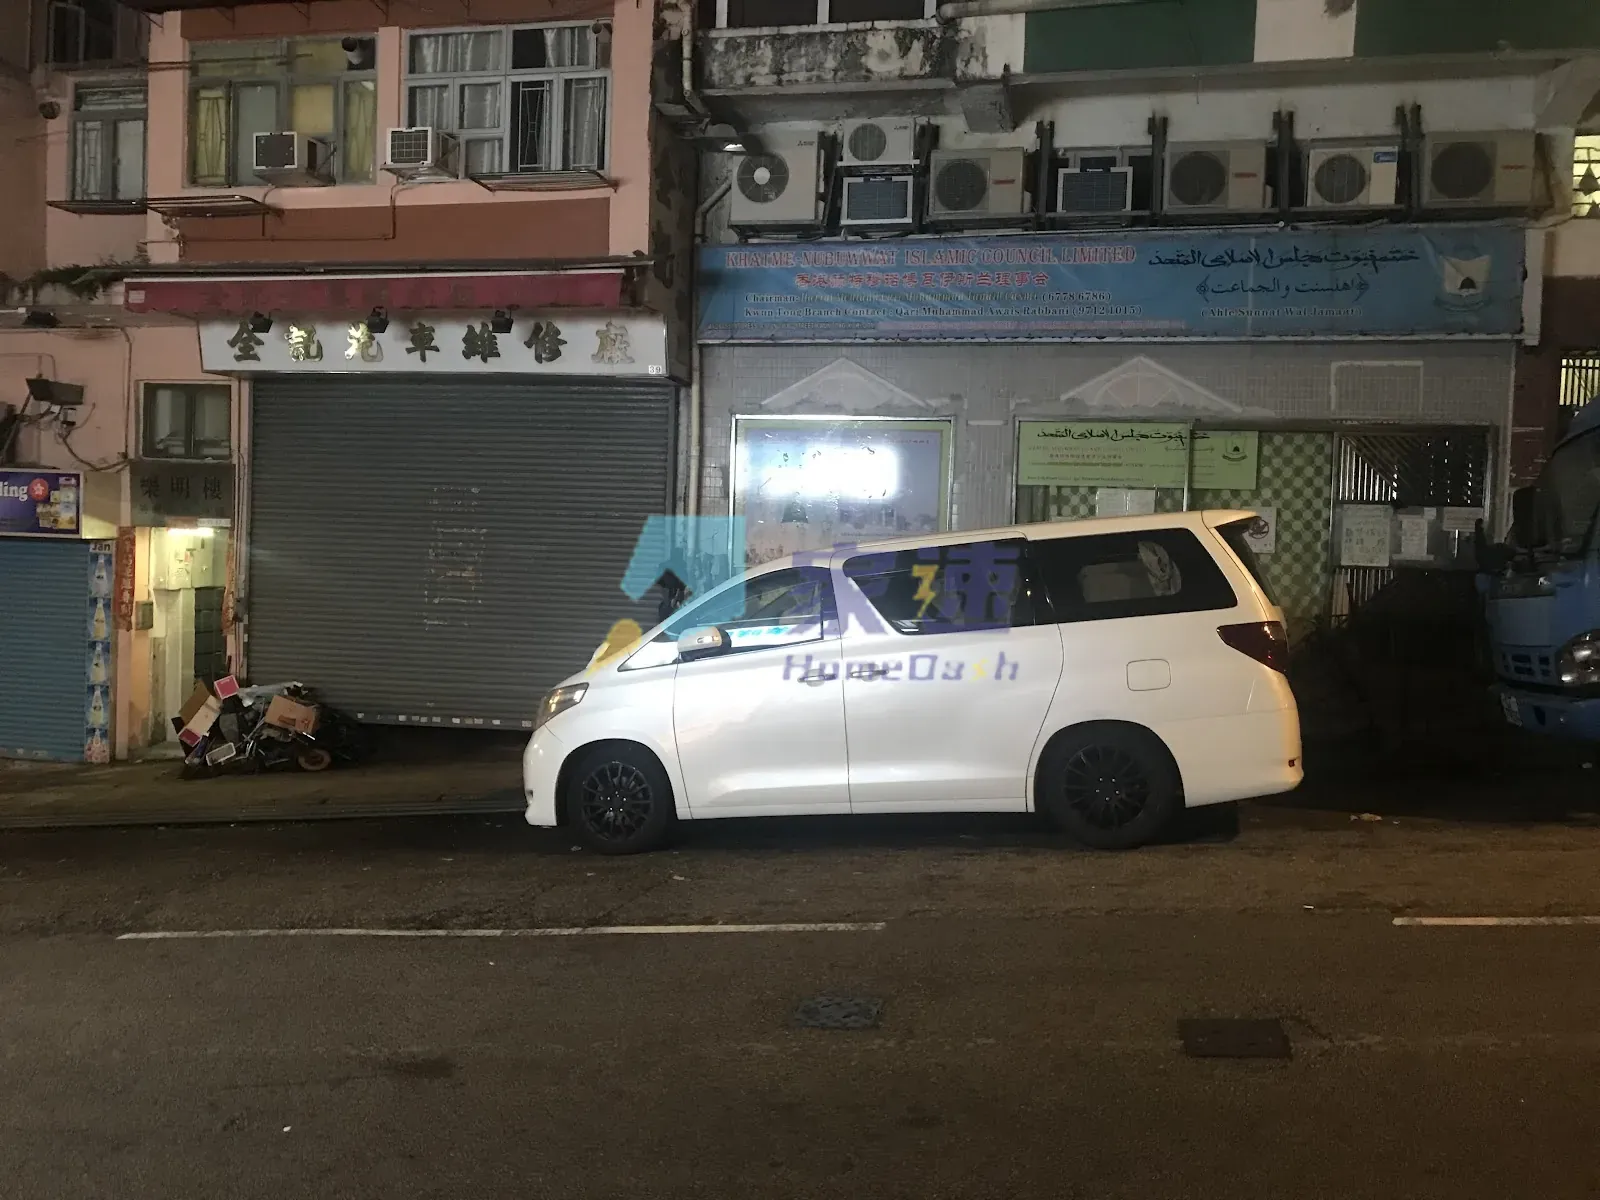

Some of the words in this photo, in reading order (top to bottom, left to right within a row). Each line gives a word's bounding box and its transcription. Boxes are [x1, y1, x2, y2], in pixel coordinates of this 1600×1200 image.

[905, 248, 977, 266] ISLAMIC
[981, 247, 1057, 265] COUNCIL
[1061, 246, 1136, 264] LIMITED
[804, 307, 842, 317] Branch
[922, 305, 984, 317] Muhammad
[1023, 305, 1069, 316] Rabbani
[226, 321, 636, 364] 全記汽車維修廠
